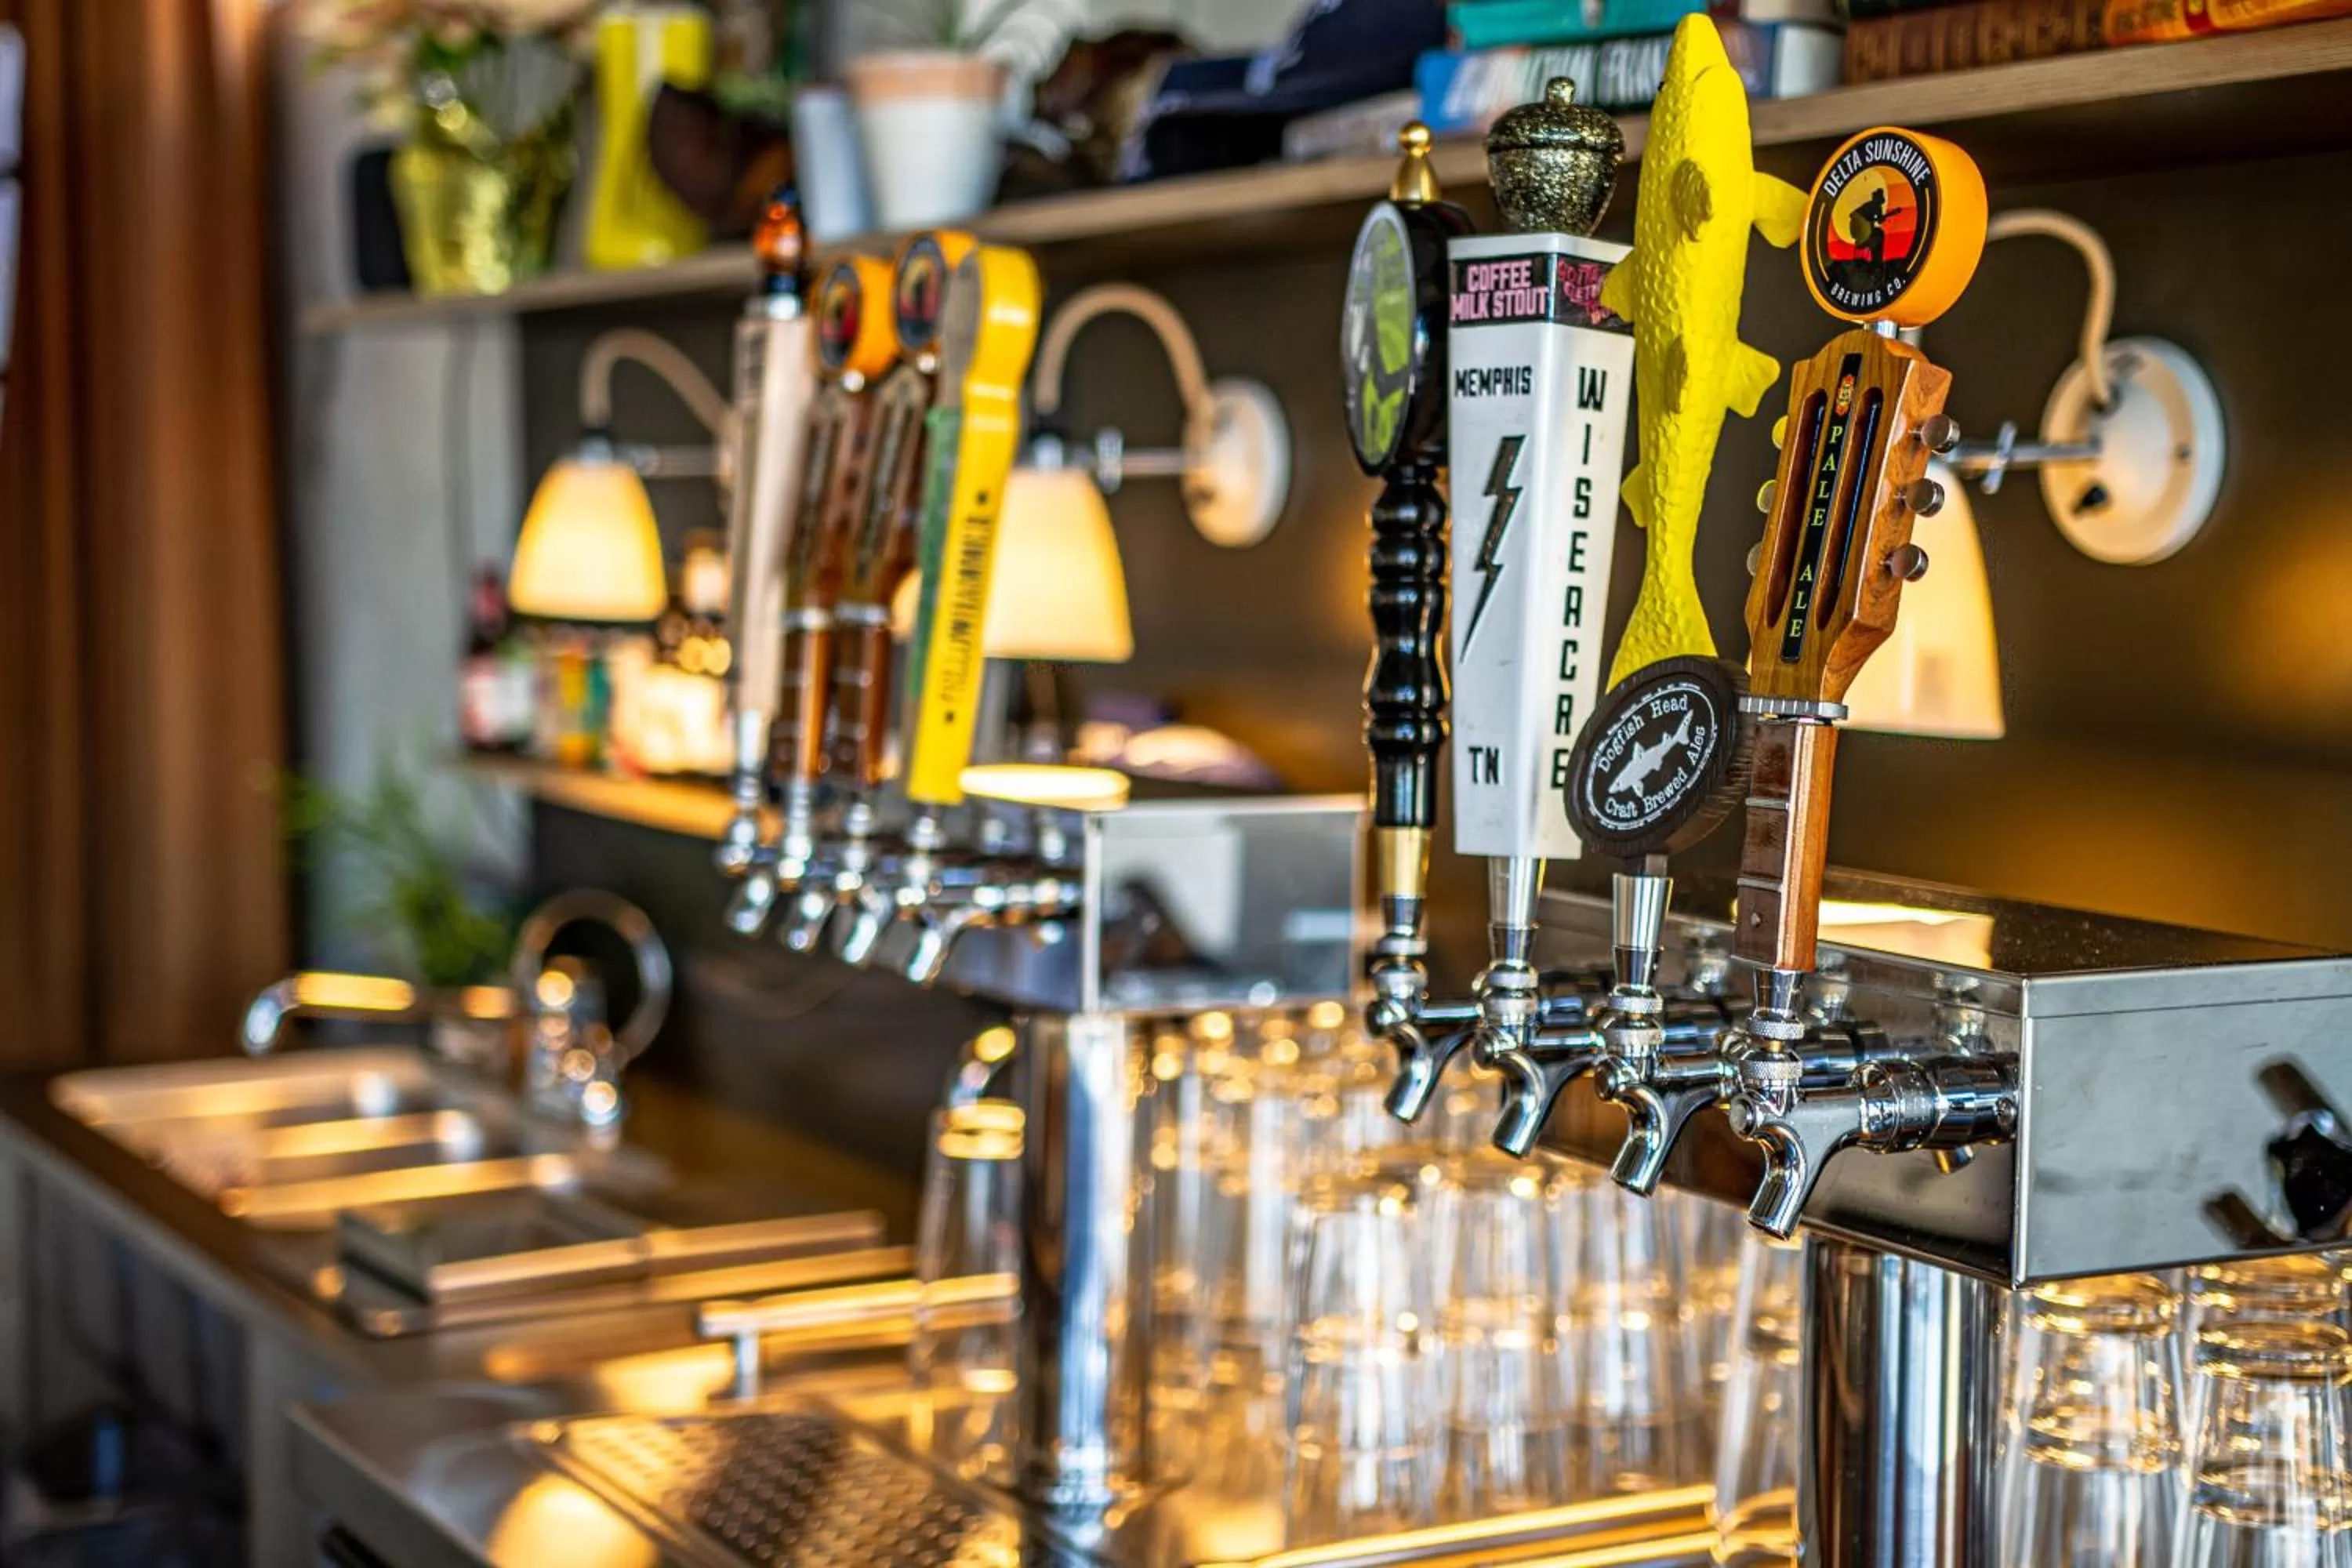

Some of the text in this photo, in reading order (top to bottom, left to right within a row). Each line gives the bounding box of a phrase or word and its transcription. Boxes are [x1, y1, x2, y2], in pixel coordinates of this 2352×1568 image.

[1823, 139, 1931, 198] DELTA SUNSHINE
[1467, 260, 1532, 292] COFFEE
[1831, 277, 1906, 307] BREWING CO.
[1450, 290, 1490, 321] MILK
[1491, 286, 1549, 318] STOUT
[1454, 365, 1532, 398] MEMPHIS
[1789, 424, 1842, 638] PALE ALE
[1551, 366, 1607, 789] WISEACRE
[1598, 714, 1646, 773] Dogfish
[1650, 694, 1688, 719] Head
[1468, 746, 1499, 785] TN
[1604, 725, 1706, 818] Craft Brewed Ales
